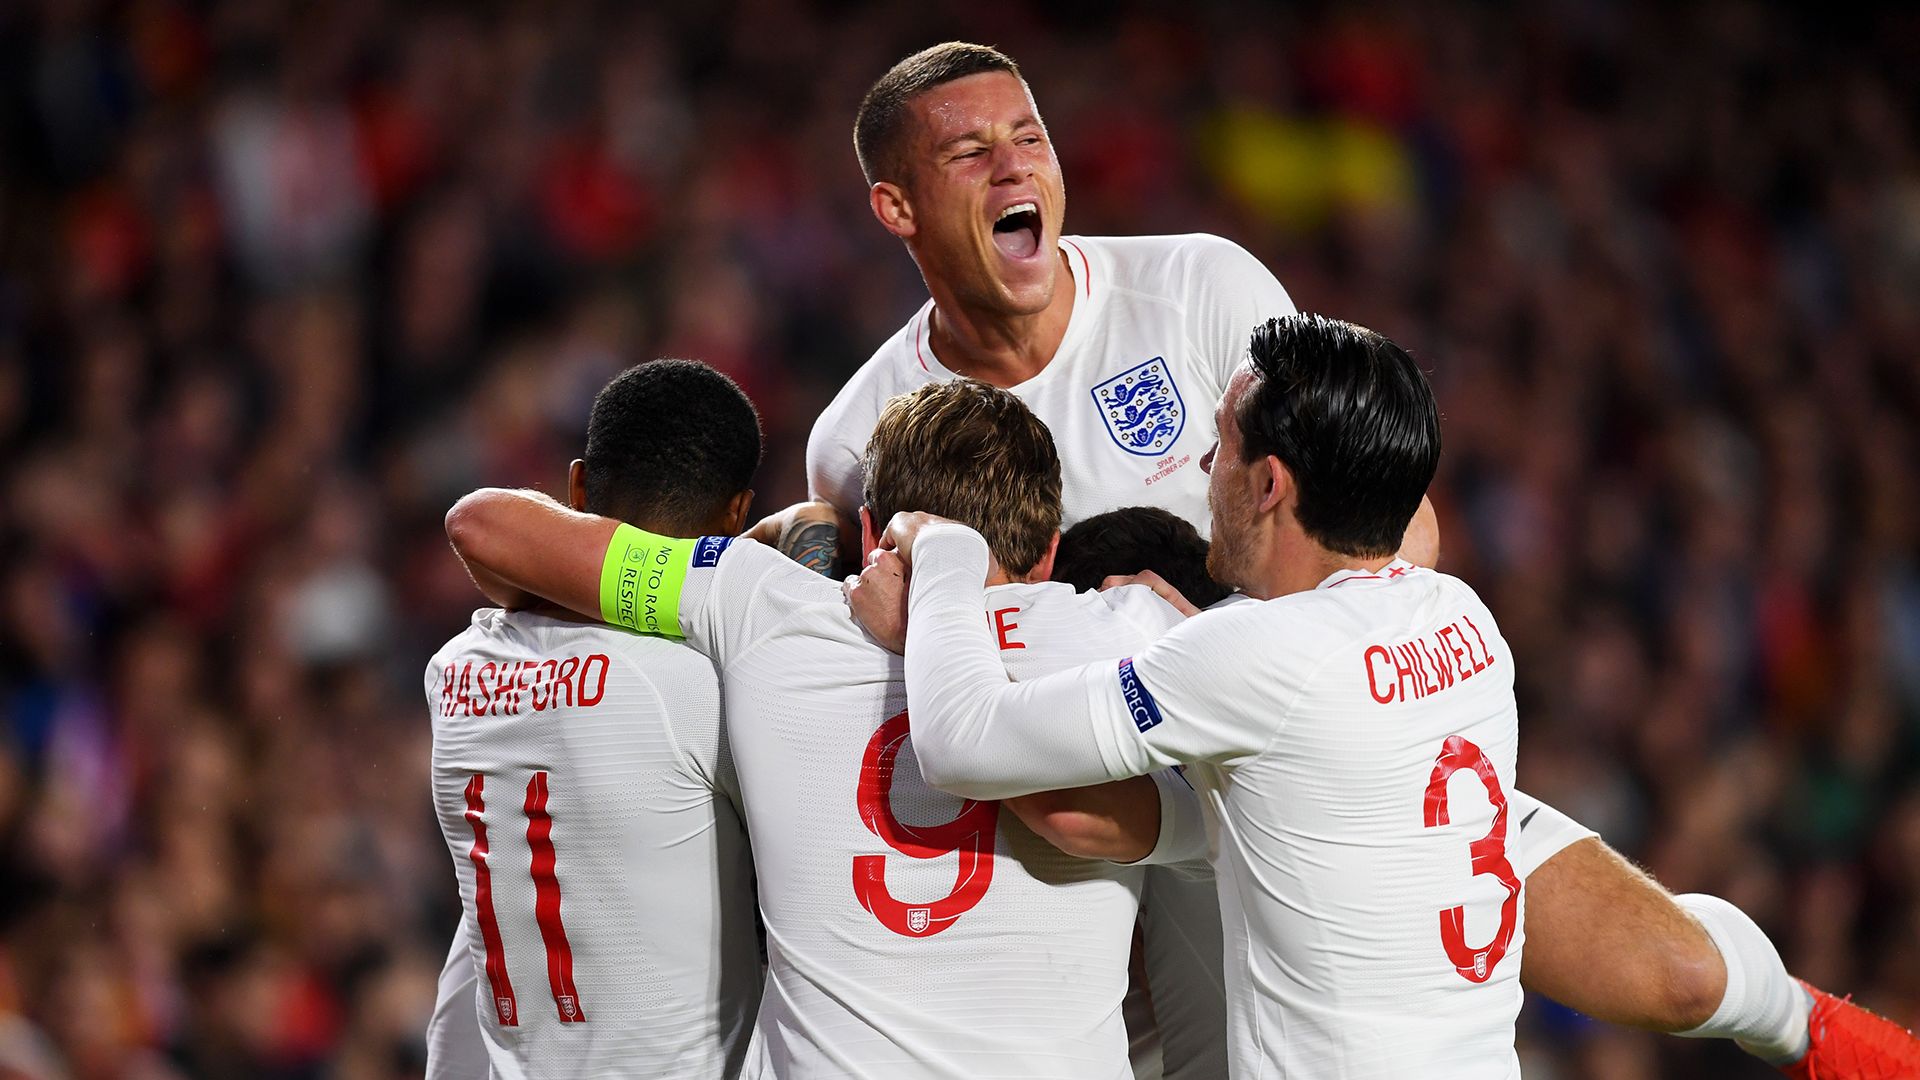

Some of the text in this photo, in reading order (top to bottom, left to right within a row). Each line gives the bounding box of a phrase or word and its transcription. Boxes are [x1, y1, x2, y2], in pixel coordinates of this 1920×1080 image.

[1152, 464, 1177, 481] OCTOBER
[1157, 456, 1175, 469] SPAIN
[648, 569, 663, 590] TO
[656, 546, 672, 565] NO
[985, 607, 1026, 650] E
[440, 654, 610, 717] RASHFORD
[1364, 616, 1495, 704] CHILWELL
[1119, 665, 1153, 727] RESPECT
[852, 708, 1000, 937] 9
[1423, 735, 1522, 983] 3
[464, 771, 587, 1026] 11
